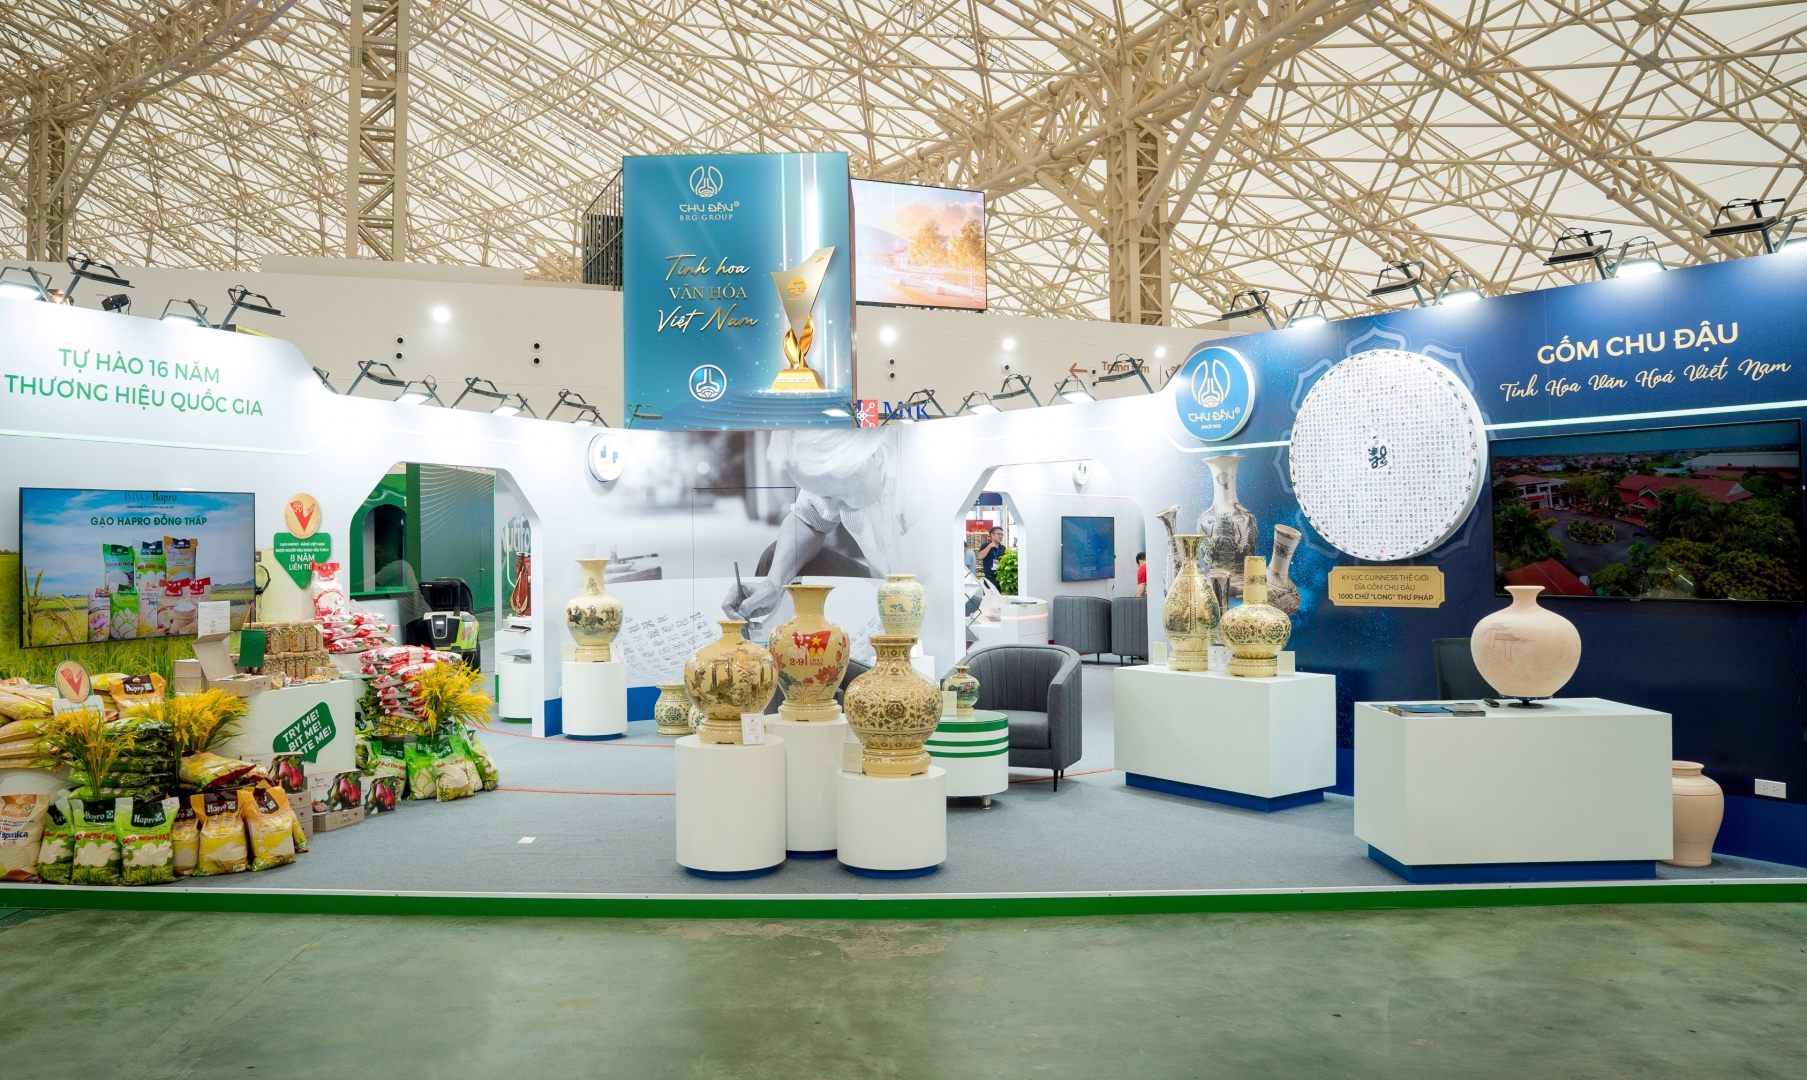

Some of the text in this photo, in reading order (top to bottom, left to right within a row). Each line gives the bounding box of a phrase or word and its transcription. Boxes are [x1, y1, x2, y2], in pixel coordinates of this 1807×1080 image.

[679, 203, 705, 213] CHU
[701, 213, 733, 221] GROUP
[665, 253, 751, 281] Tinh hoa
[669, 282, 748, 300] VĂN HÓA
[657, 303, 759, 334] Việt Nam
[1537, 320, 1739, 365] GỐM CHU ĐẬU
[58, 347, 220, 384] TỰ HÀO 16 NĂM
[1500, 356, 1792, 402] Tinh Hoa Văn Hoá Việt Nam
[4, 374, 263, 417] THƯƠNG HIỆU QUỐC GIA
[1188, 411, 1211, 423] CHU
[124, 491, 177, 504] BRG Hapro
[90, 513, 208, 528] GẠO HAPRO ĐỒNG THÁP
[290, 552, 315, 562] 8 NĂM
[288, 561, 312, 571] LIÊN TIẾ
[1351, 574, 1364, 582] LỤC
[1414, 573, 1429, 582] GIỚI
[1366, 582, 1383, 591] GỐM
[1400, 583, 1416, 592] ĐẬU
[1354, 592, 1370, 600] CHỮ
[1371, 593, 1396, 601] "LONG"
[1413, 593, 1434, 601] PHÁP
[808, 647, 824, 657] 80
[789, 657, 804, 666] 2-9
[282, 709, 320, 742] TRY ME!
[288, 720, 322, 752] BIT ME!
[314, 725, 332, 744] ME!
[207, 803, 226, 813] Hapro
[85, 810, 104, 822] Hapro
